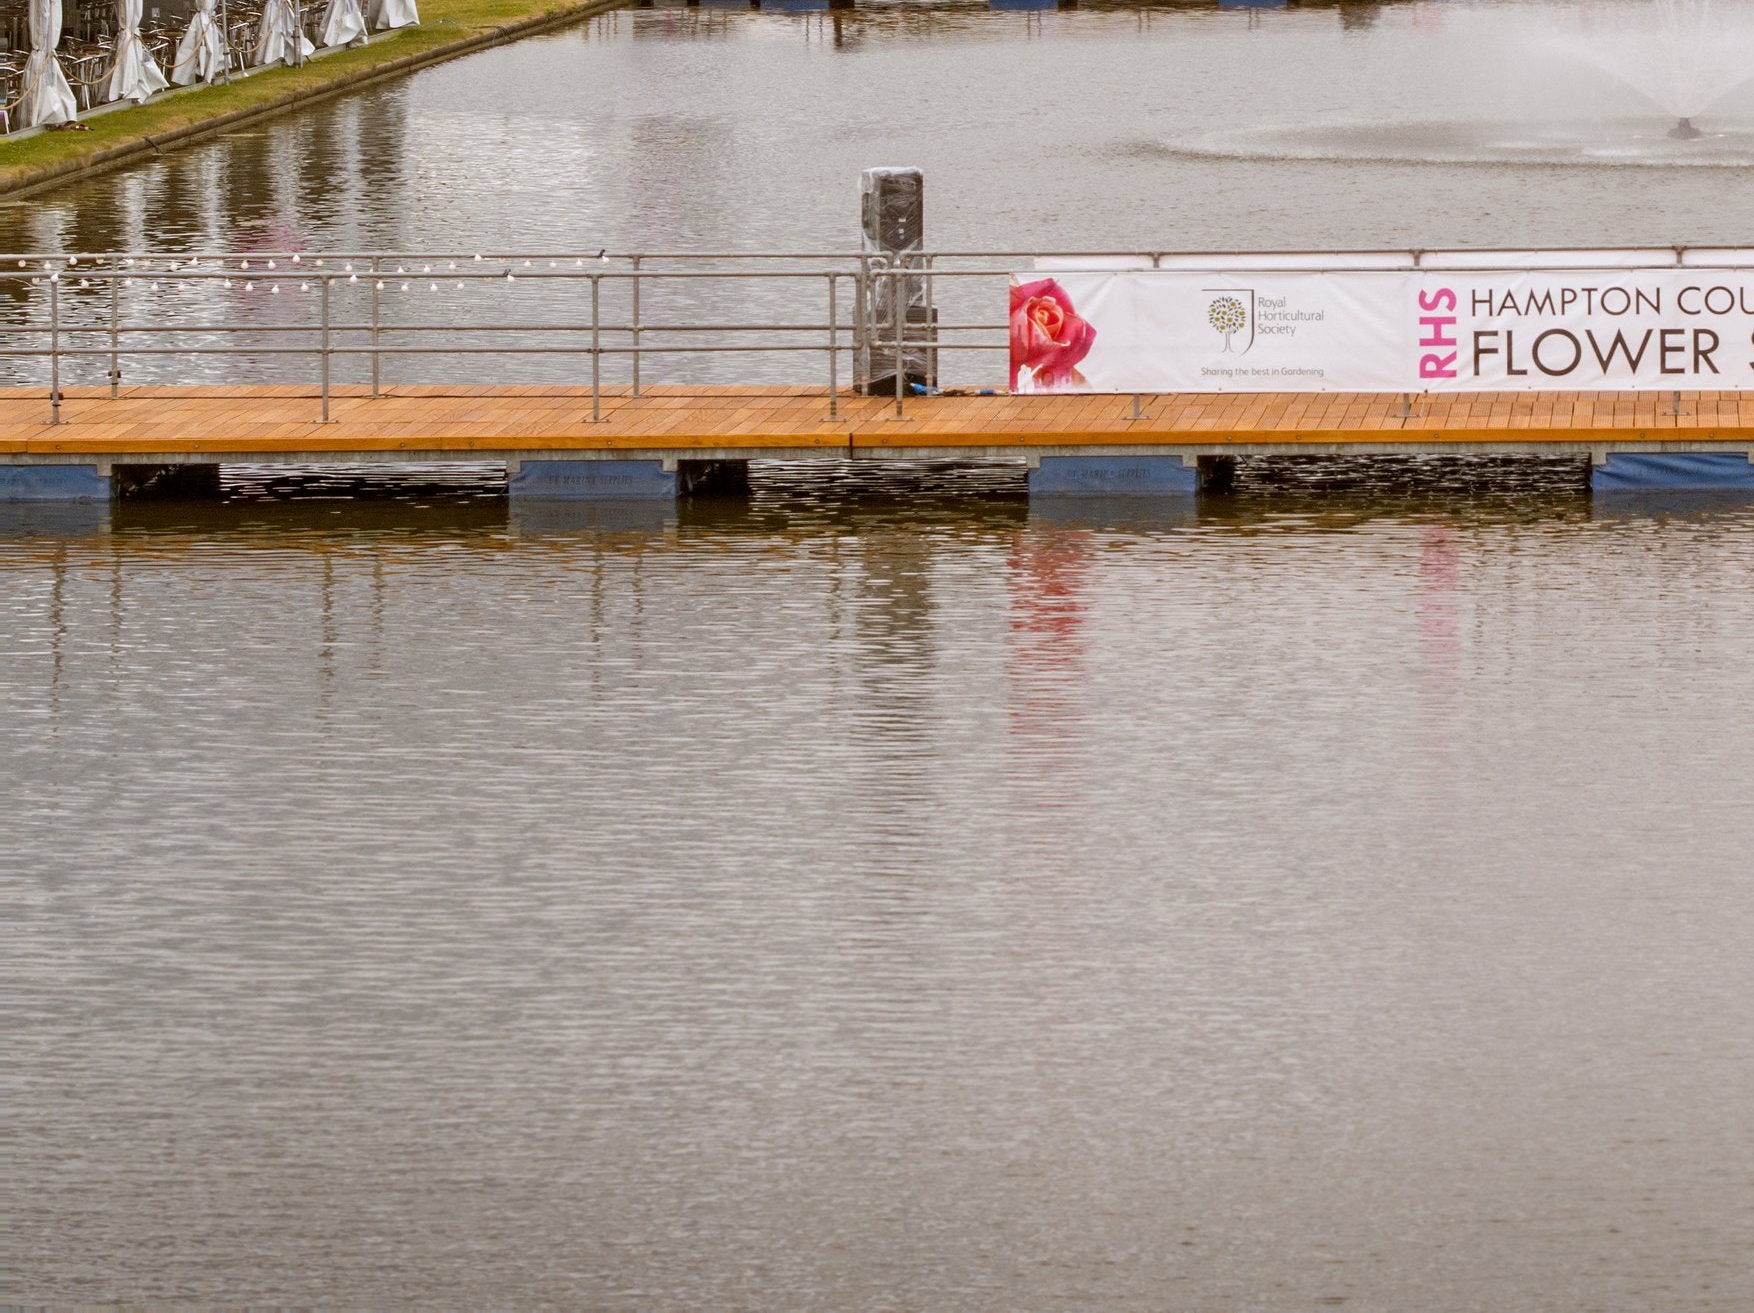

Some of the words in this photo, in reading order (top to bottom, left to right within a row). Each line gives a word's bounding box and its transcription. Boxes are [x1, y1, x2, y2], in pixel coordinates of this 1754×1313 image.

[1258, 296, 1286, 310] Royal
[1471, 286, 1661, 317] HAMPTON
[1258, 310, 1325, 321] Horticultural
[1258, 324, 1296, 337] Society
[1418, 287, 1457, 379] RHS
[1472, 328, 1720, 376] FLOWER
[1201, 367, 1233, 378] Sharing
[1235, 367, 1249, 376] the
[1252, 367, 1269, 376] best
[1271, 367, 1280, 376] in
[1281, 366, 1324, 377] Gardening
